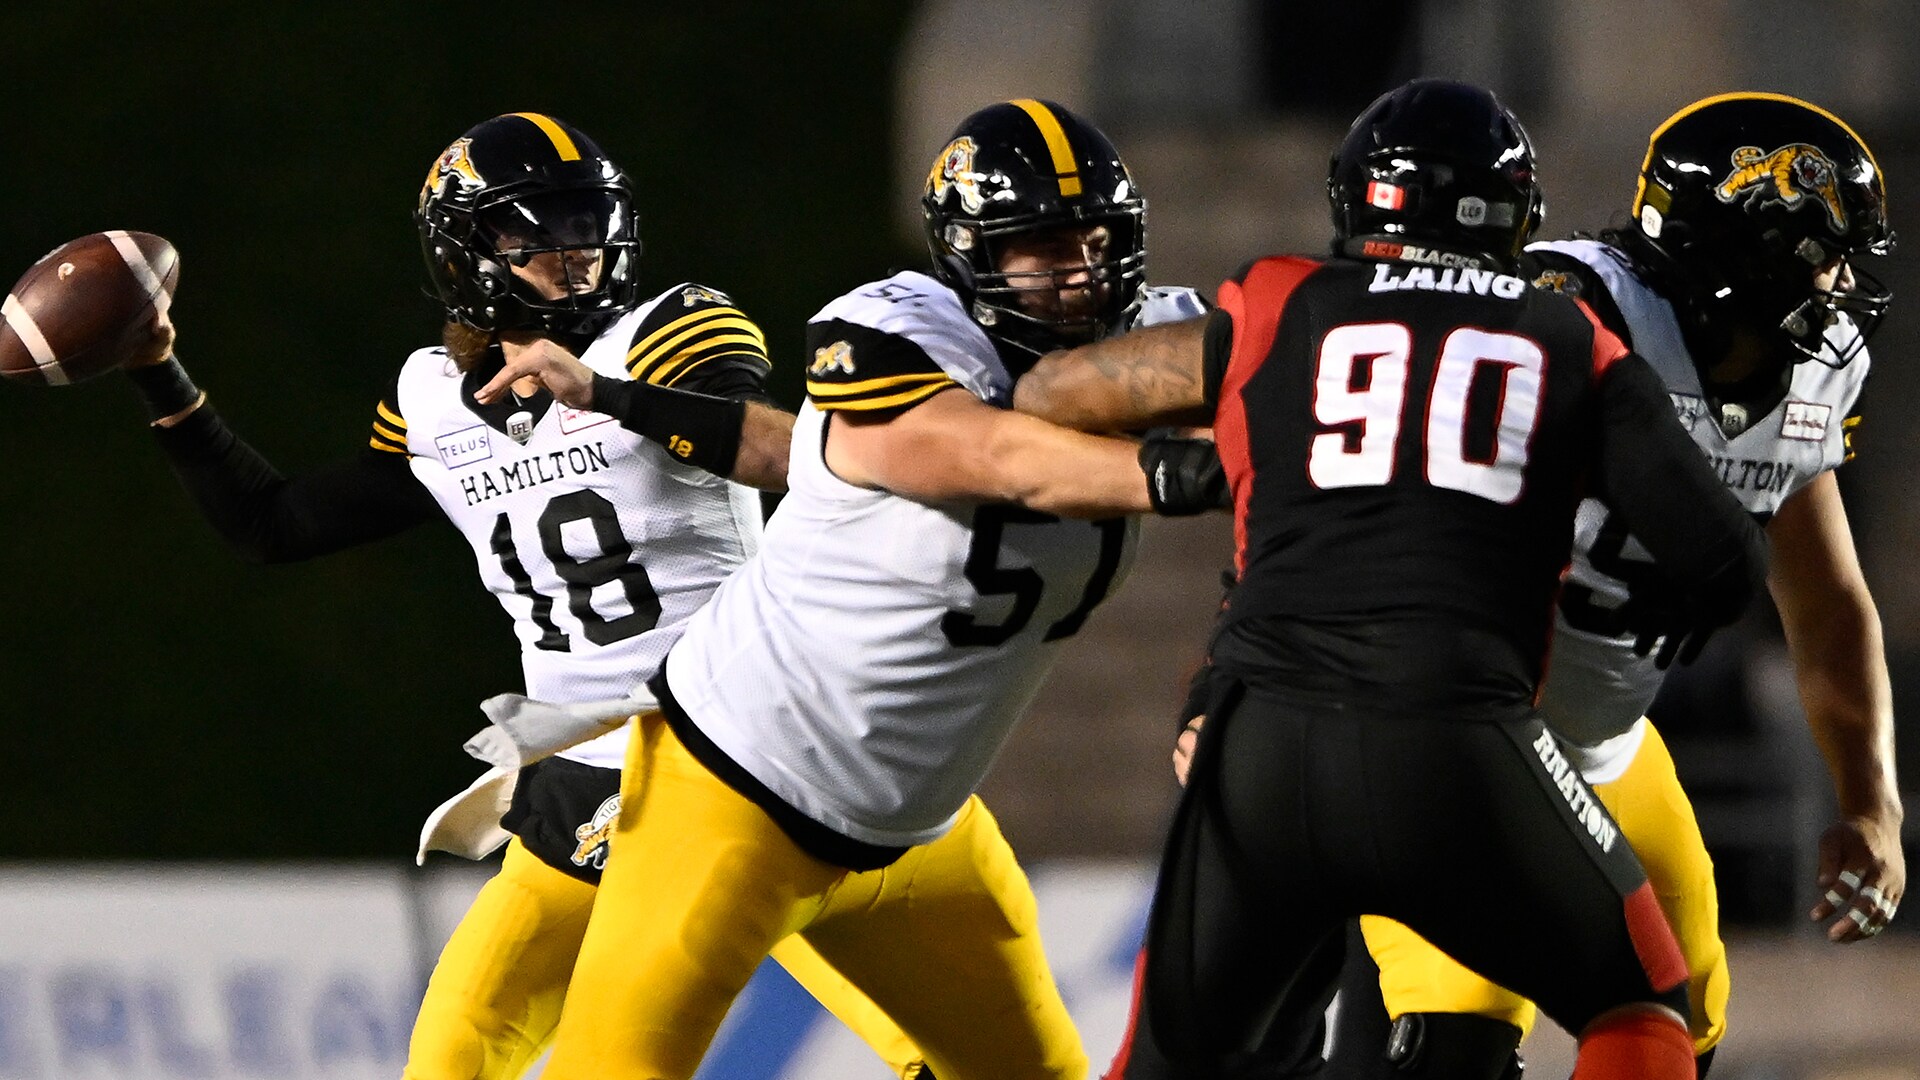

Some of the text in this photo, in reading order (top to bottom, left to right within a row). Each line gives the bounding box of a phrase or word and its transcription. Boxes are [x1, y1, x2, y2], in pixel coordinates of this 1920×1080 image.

[1363, 241, 1480, 269] REDBLACKS
[1368, 263, 1526, 300] LAING
[1307, 321, 1547, 506] 90
[440, 436, 488, 459] TELUS
[460, 441, 611, 506] HAMILTON
[667, 434, 695, 459] 18
[489, 487, 663, 653] 18
[941, 502, 1126, 648] 57
[1533, 727, 1618, 854] RNATION
